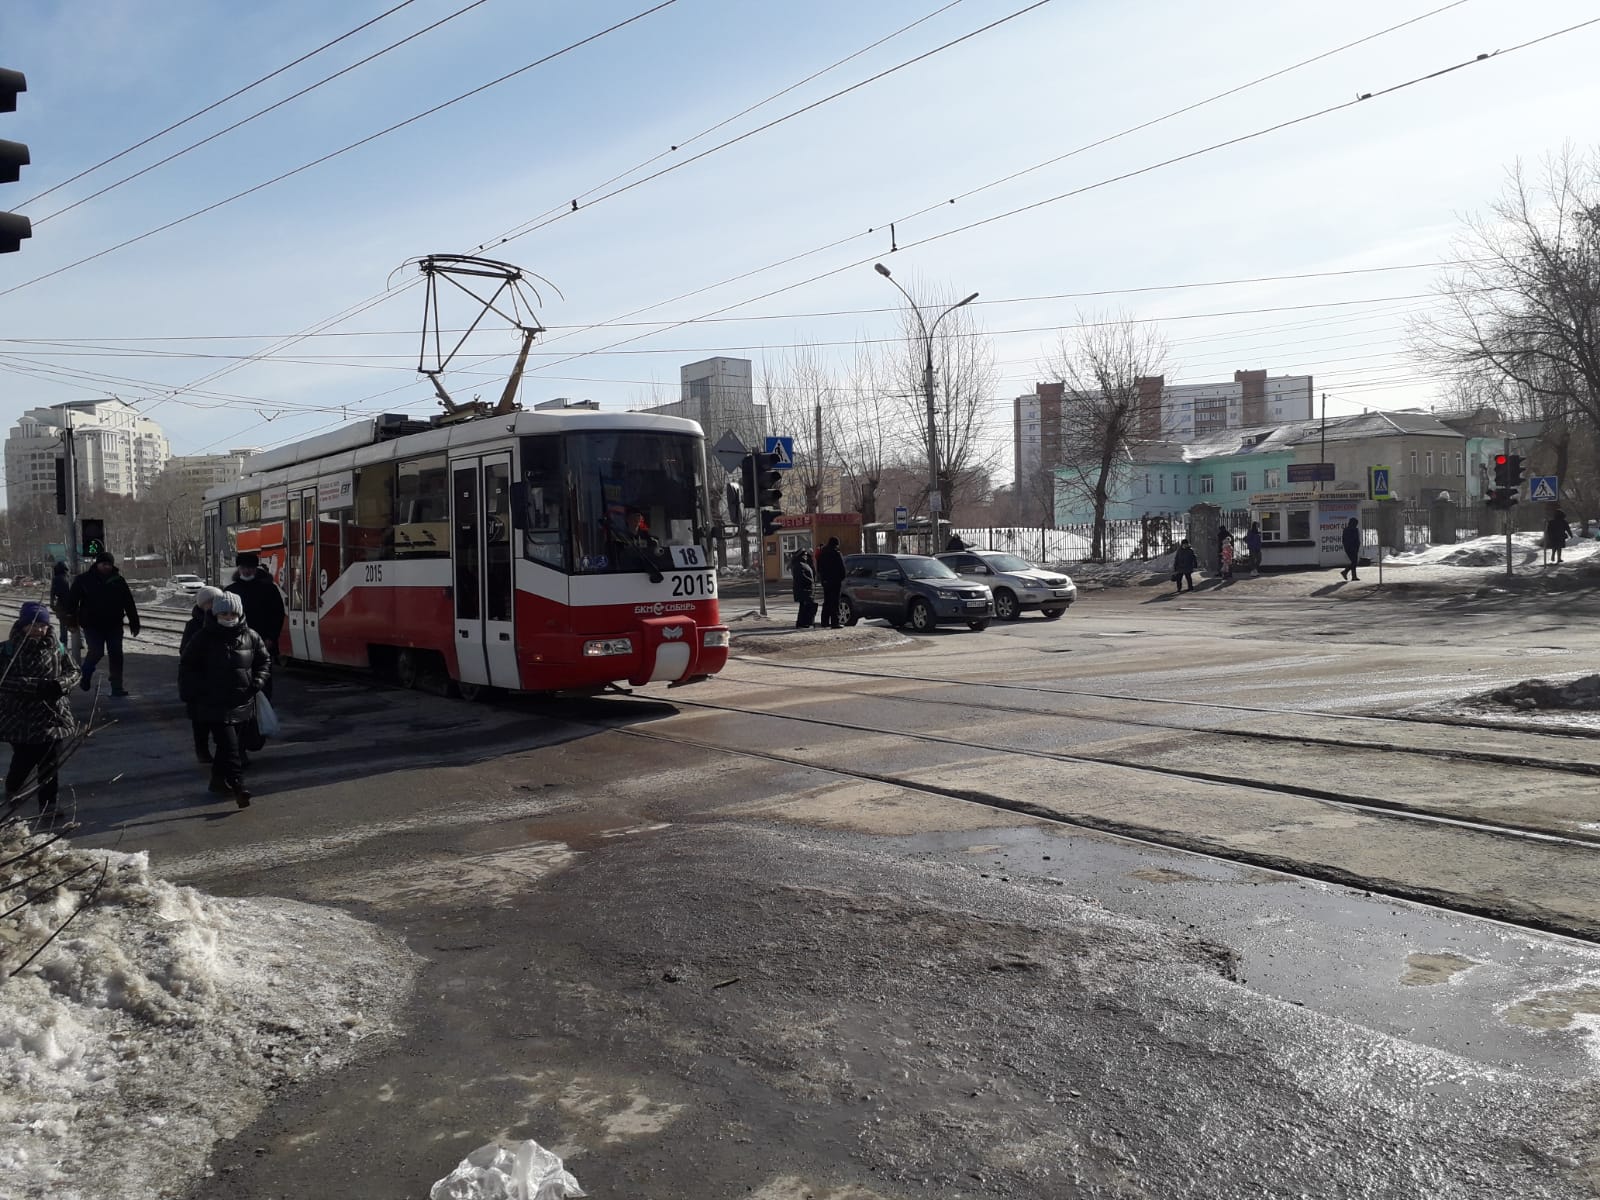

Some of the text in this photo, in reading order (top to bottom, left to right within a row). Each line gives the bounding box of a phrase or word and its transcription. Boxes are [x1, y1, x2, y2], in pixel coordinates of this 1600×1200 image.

[1321, 536, 1343, 544] СРОЧН
[1321, 544, 1344, 552] РЕМОН
[679, 547, 698, 565] 18
[365, 564, 382, 582] 2015
[671, 574, 714, 596] 2015
[634, 603, 695, 614] БКМ СИБИРЬ
